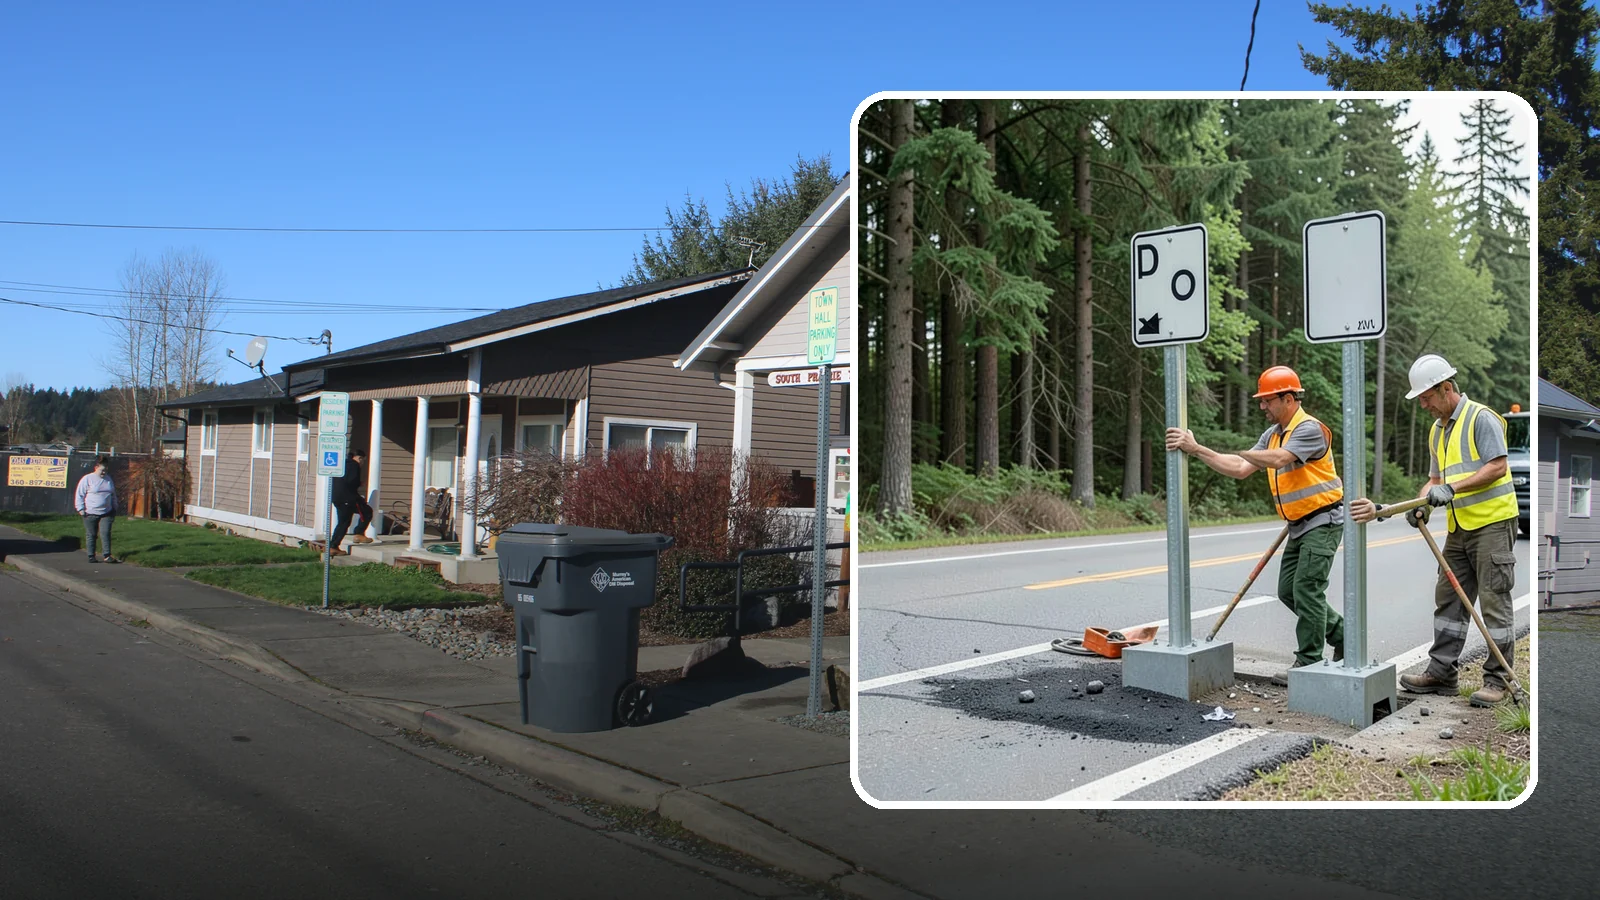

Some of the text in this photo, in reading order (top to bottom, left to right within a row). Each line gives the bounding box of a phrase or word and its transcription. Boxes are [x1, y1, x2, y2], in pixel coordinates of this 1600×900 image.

[815, 294, 832, 308] TOWN
[815, 311, 831, 324] HALL
[810, 326, 836, 340] PARKING
[814, 343, 831, 357] ONLY
[775, 373, 801, 384] SOUTH
